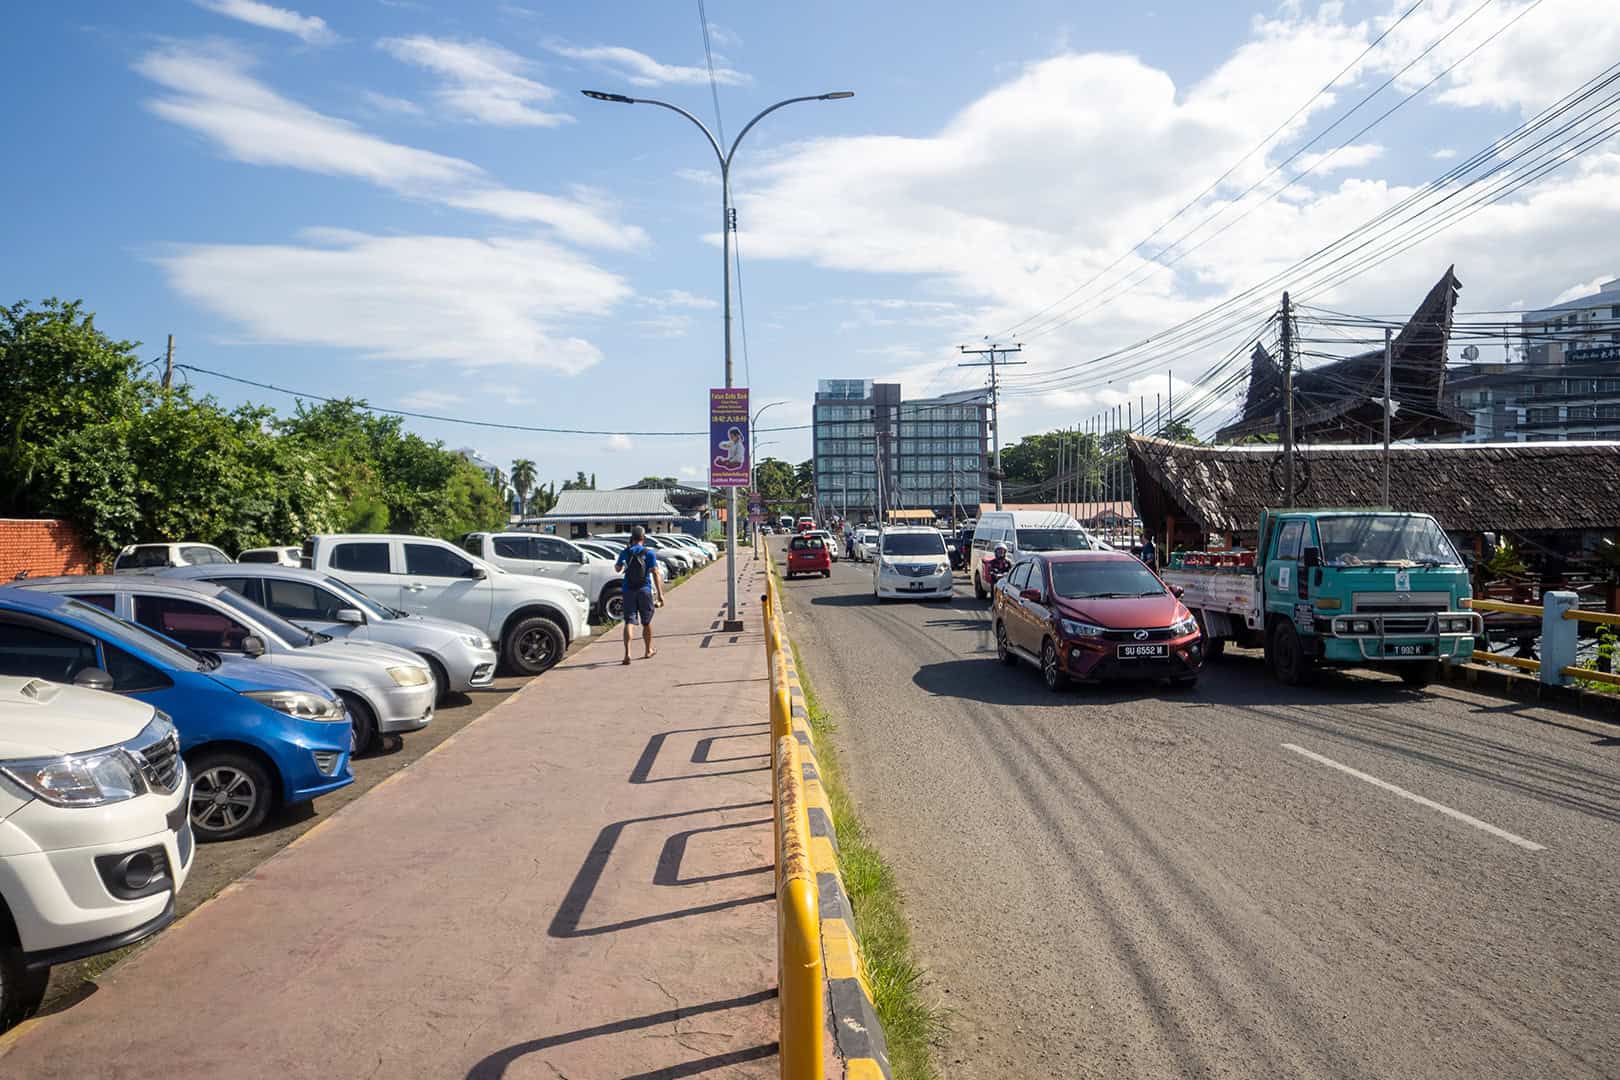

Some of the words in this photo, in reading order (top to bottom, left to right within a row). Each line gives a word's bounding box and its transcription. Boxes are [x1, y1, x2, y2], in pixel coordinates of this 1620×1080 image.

[1125, 647, 1135, 655] SU
[1136, 647, 1156, 655] 6552
[1394, 646, 1399, 655] T
